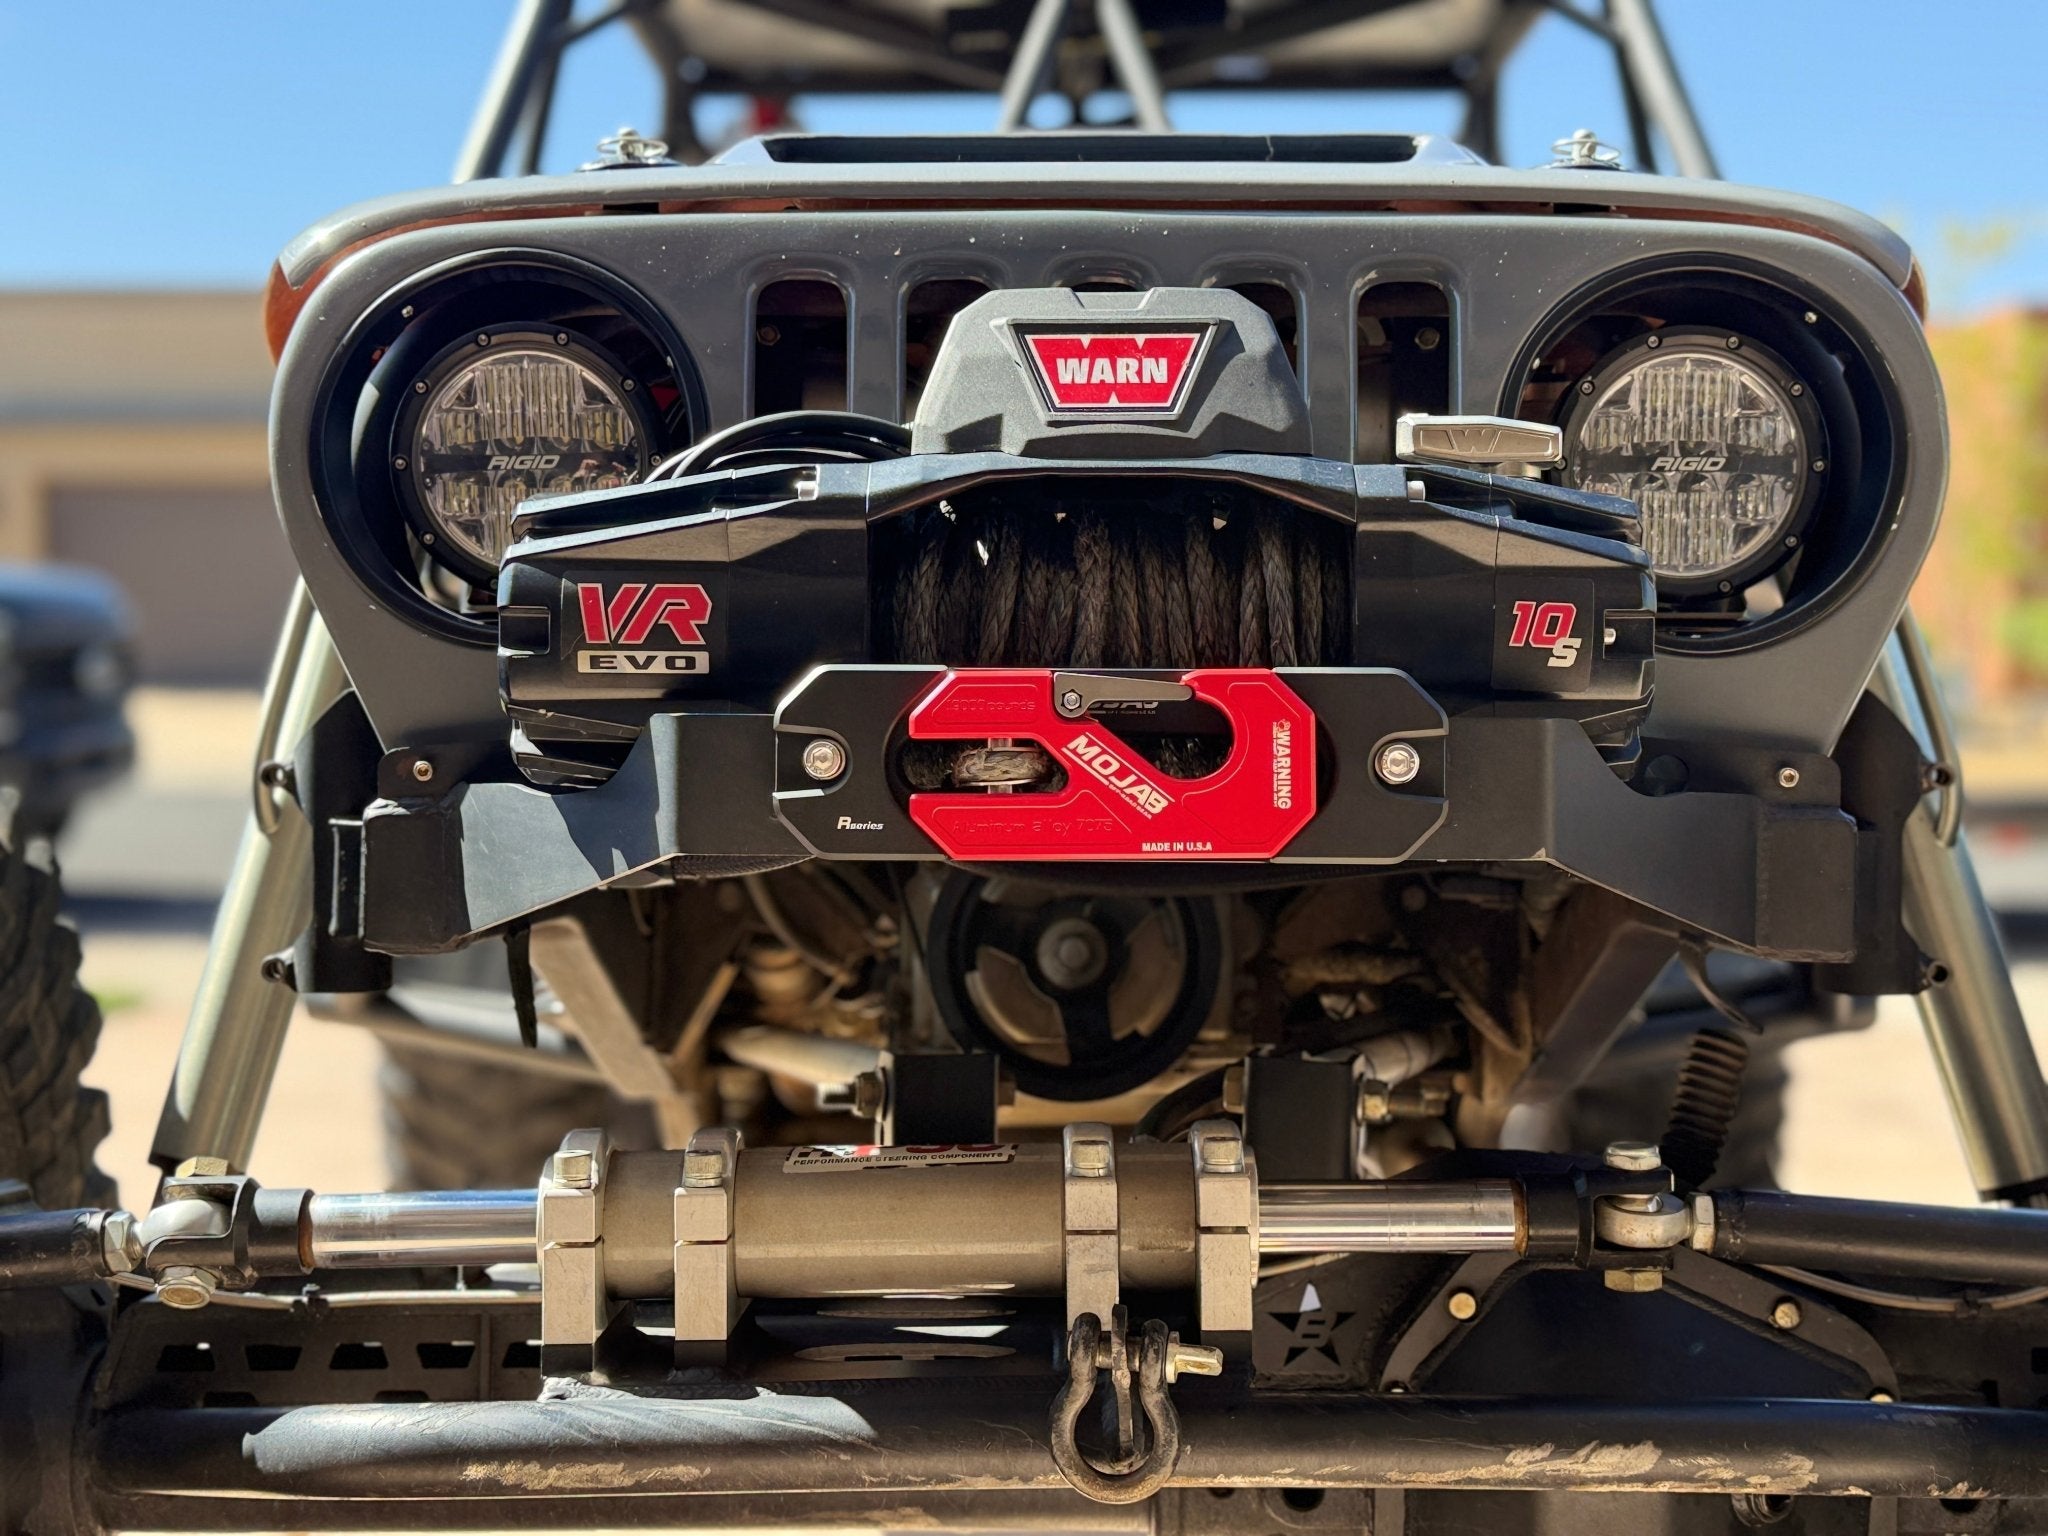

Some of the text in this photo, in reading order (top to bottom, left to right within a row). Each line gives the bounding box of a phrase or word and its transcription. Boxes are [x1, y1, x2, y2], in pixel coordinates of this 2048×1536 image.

[1056, 357, 1168, 384] WARN
[487, 455, 560, 470] RIGID
[1651, 456, 1726, 471] RIGID
[577, 583, 712, 645] VR
[589, 655, 698, 670] EVO
[1067, 735, 1168, 814] MOJAB
[1277, 730, 1292, 809] WARNING
[1142, 842, 1170, 852] MADE
[1173, 842, 1184, 852] IN
[793, 1156, 872, 1166] PERFORMANCE
[930, 1152, 1003, 1160] COMPONENTS
